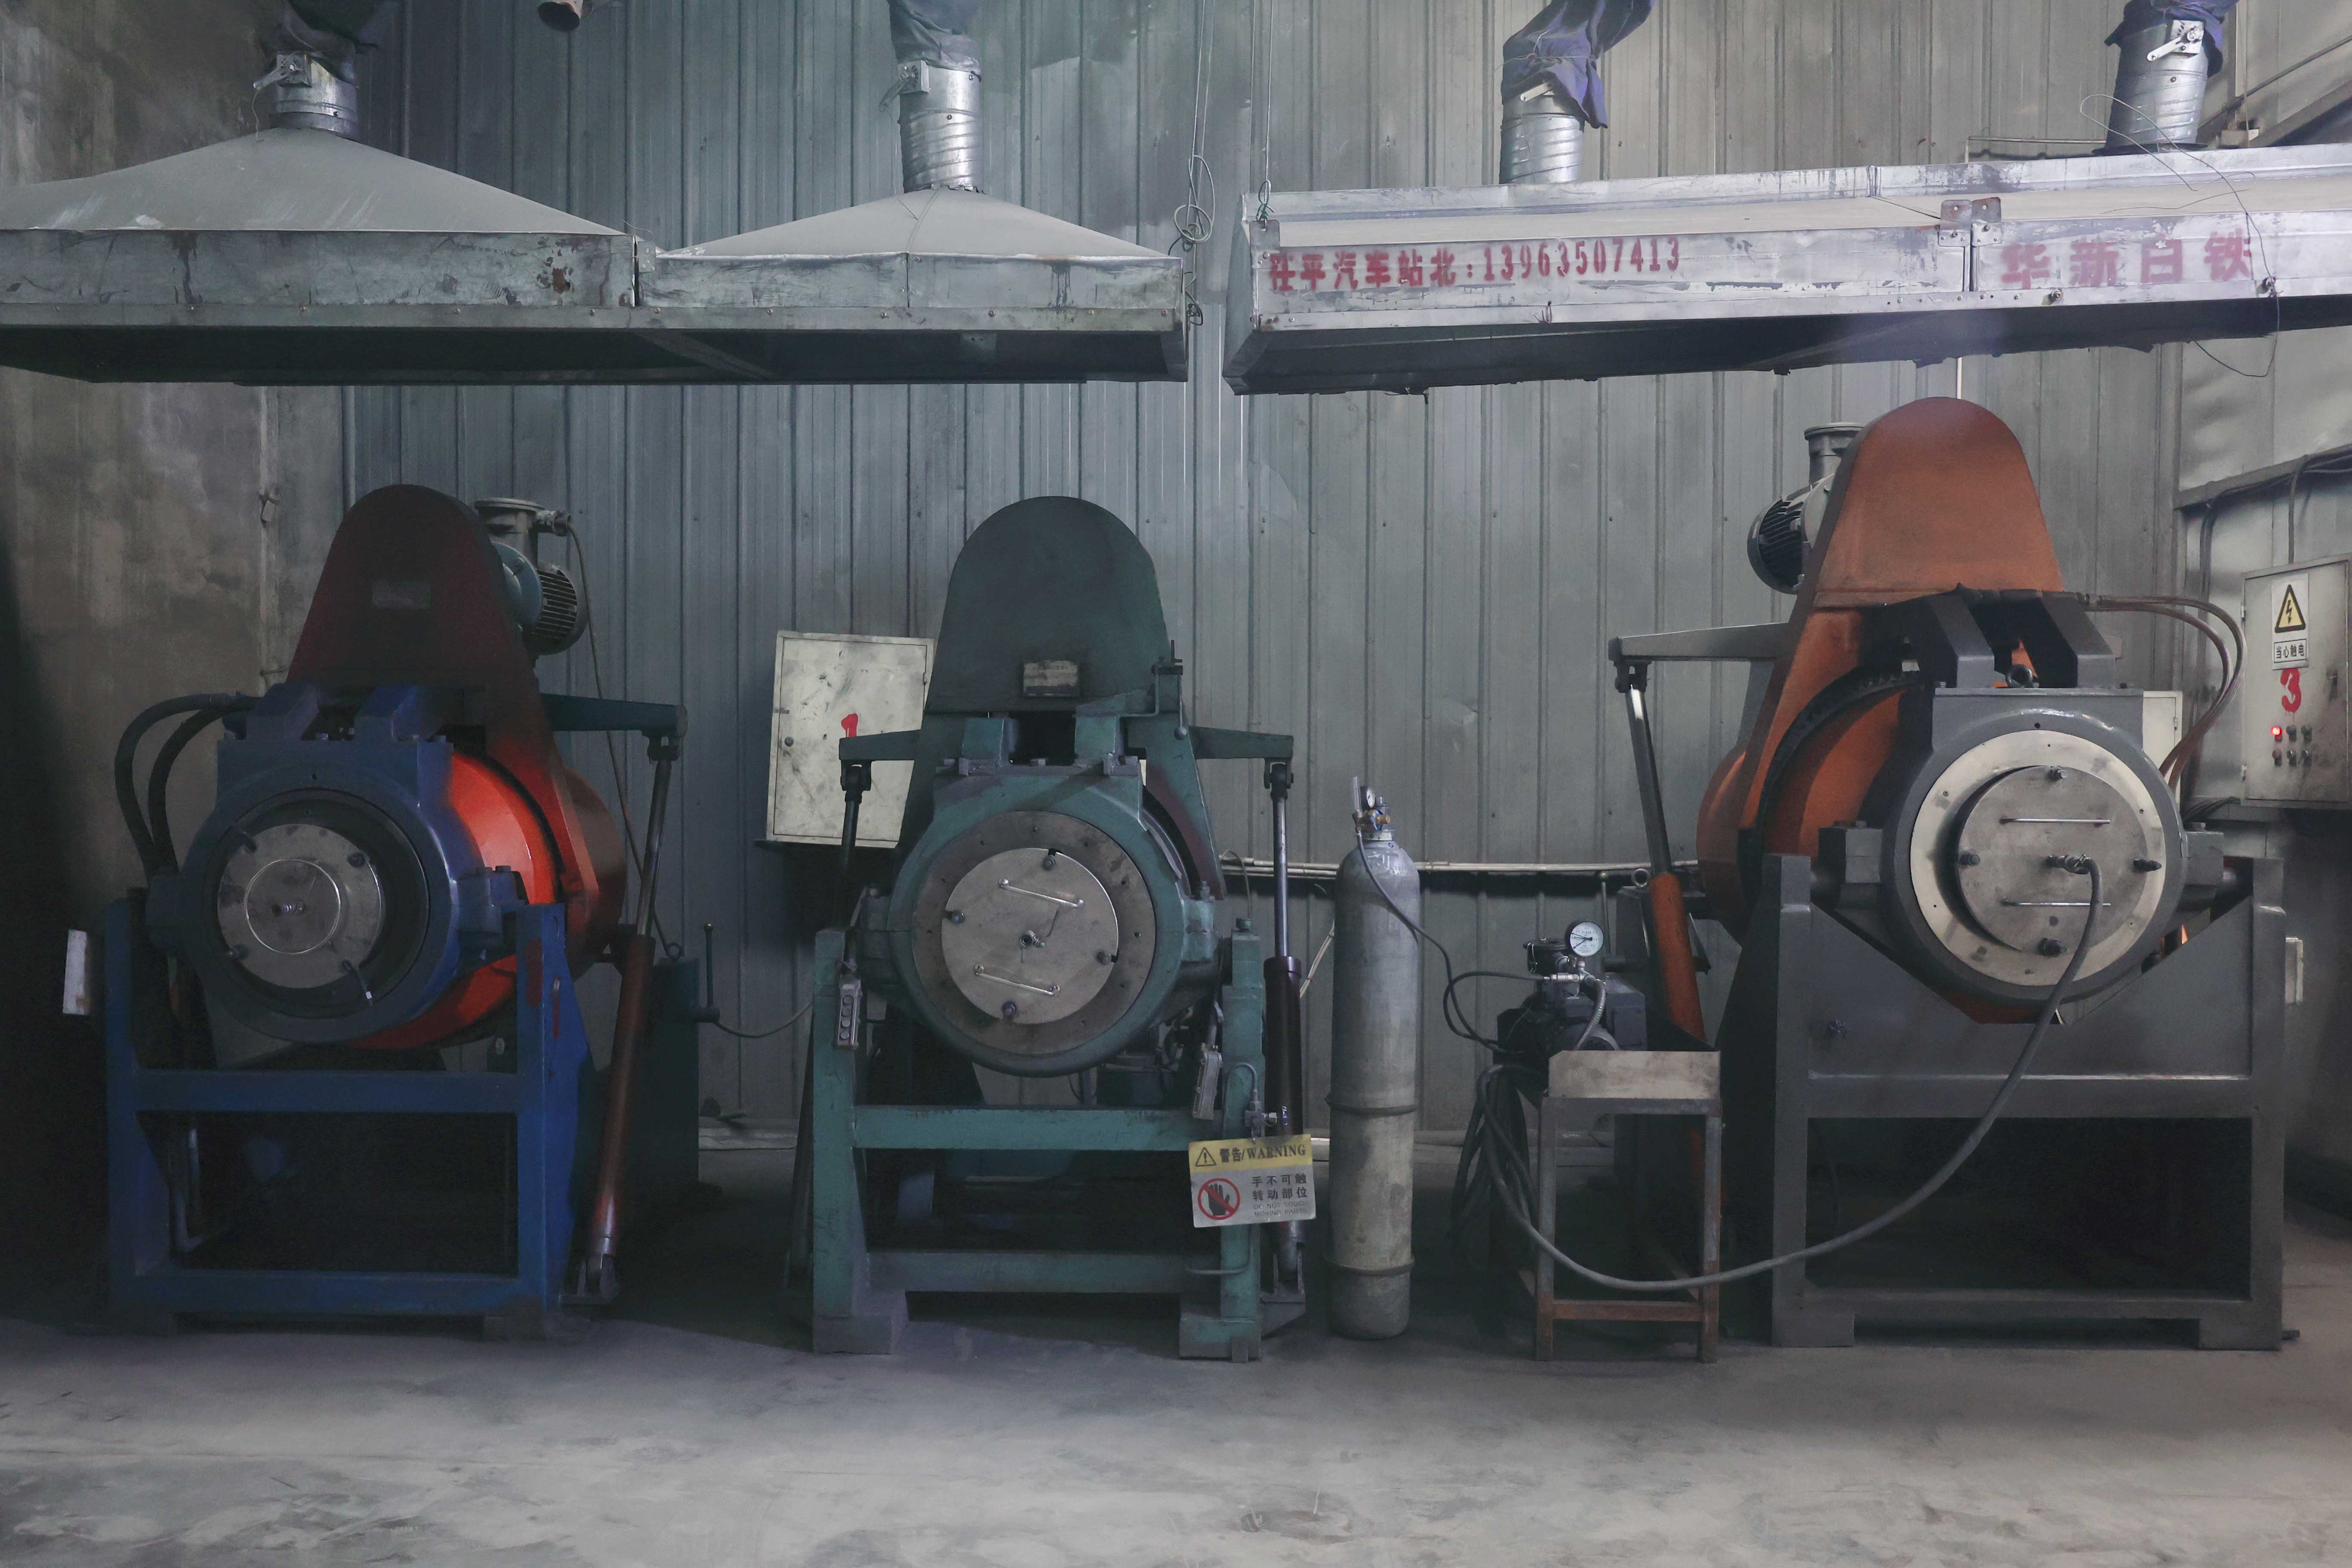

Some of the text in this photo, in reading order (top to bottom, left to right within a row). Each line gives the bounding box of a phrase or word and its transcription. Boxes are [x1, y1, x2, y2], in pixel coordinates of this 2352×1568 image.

[2276, 643, 2304, 658] 当心触电
[2280, 668, 2301, 713] 3
[1252, 1173, 1307, 1187] 手不可触
[1253, 1187, 1307, 1200] 转动部位
